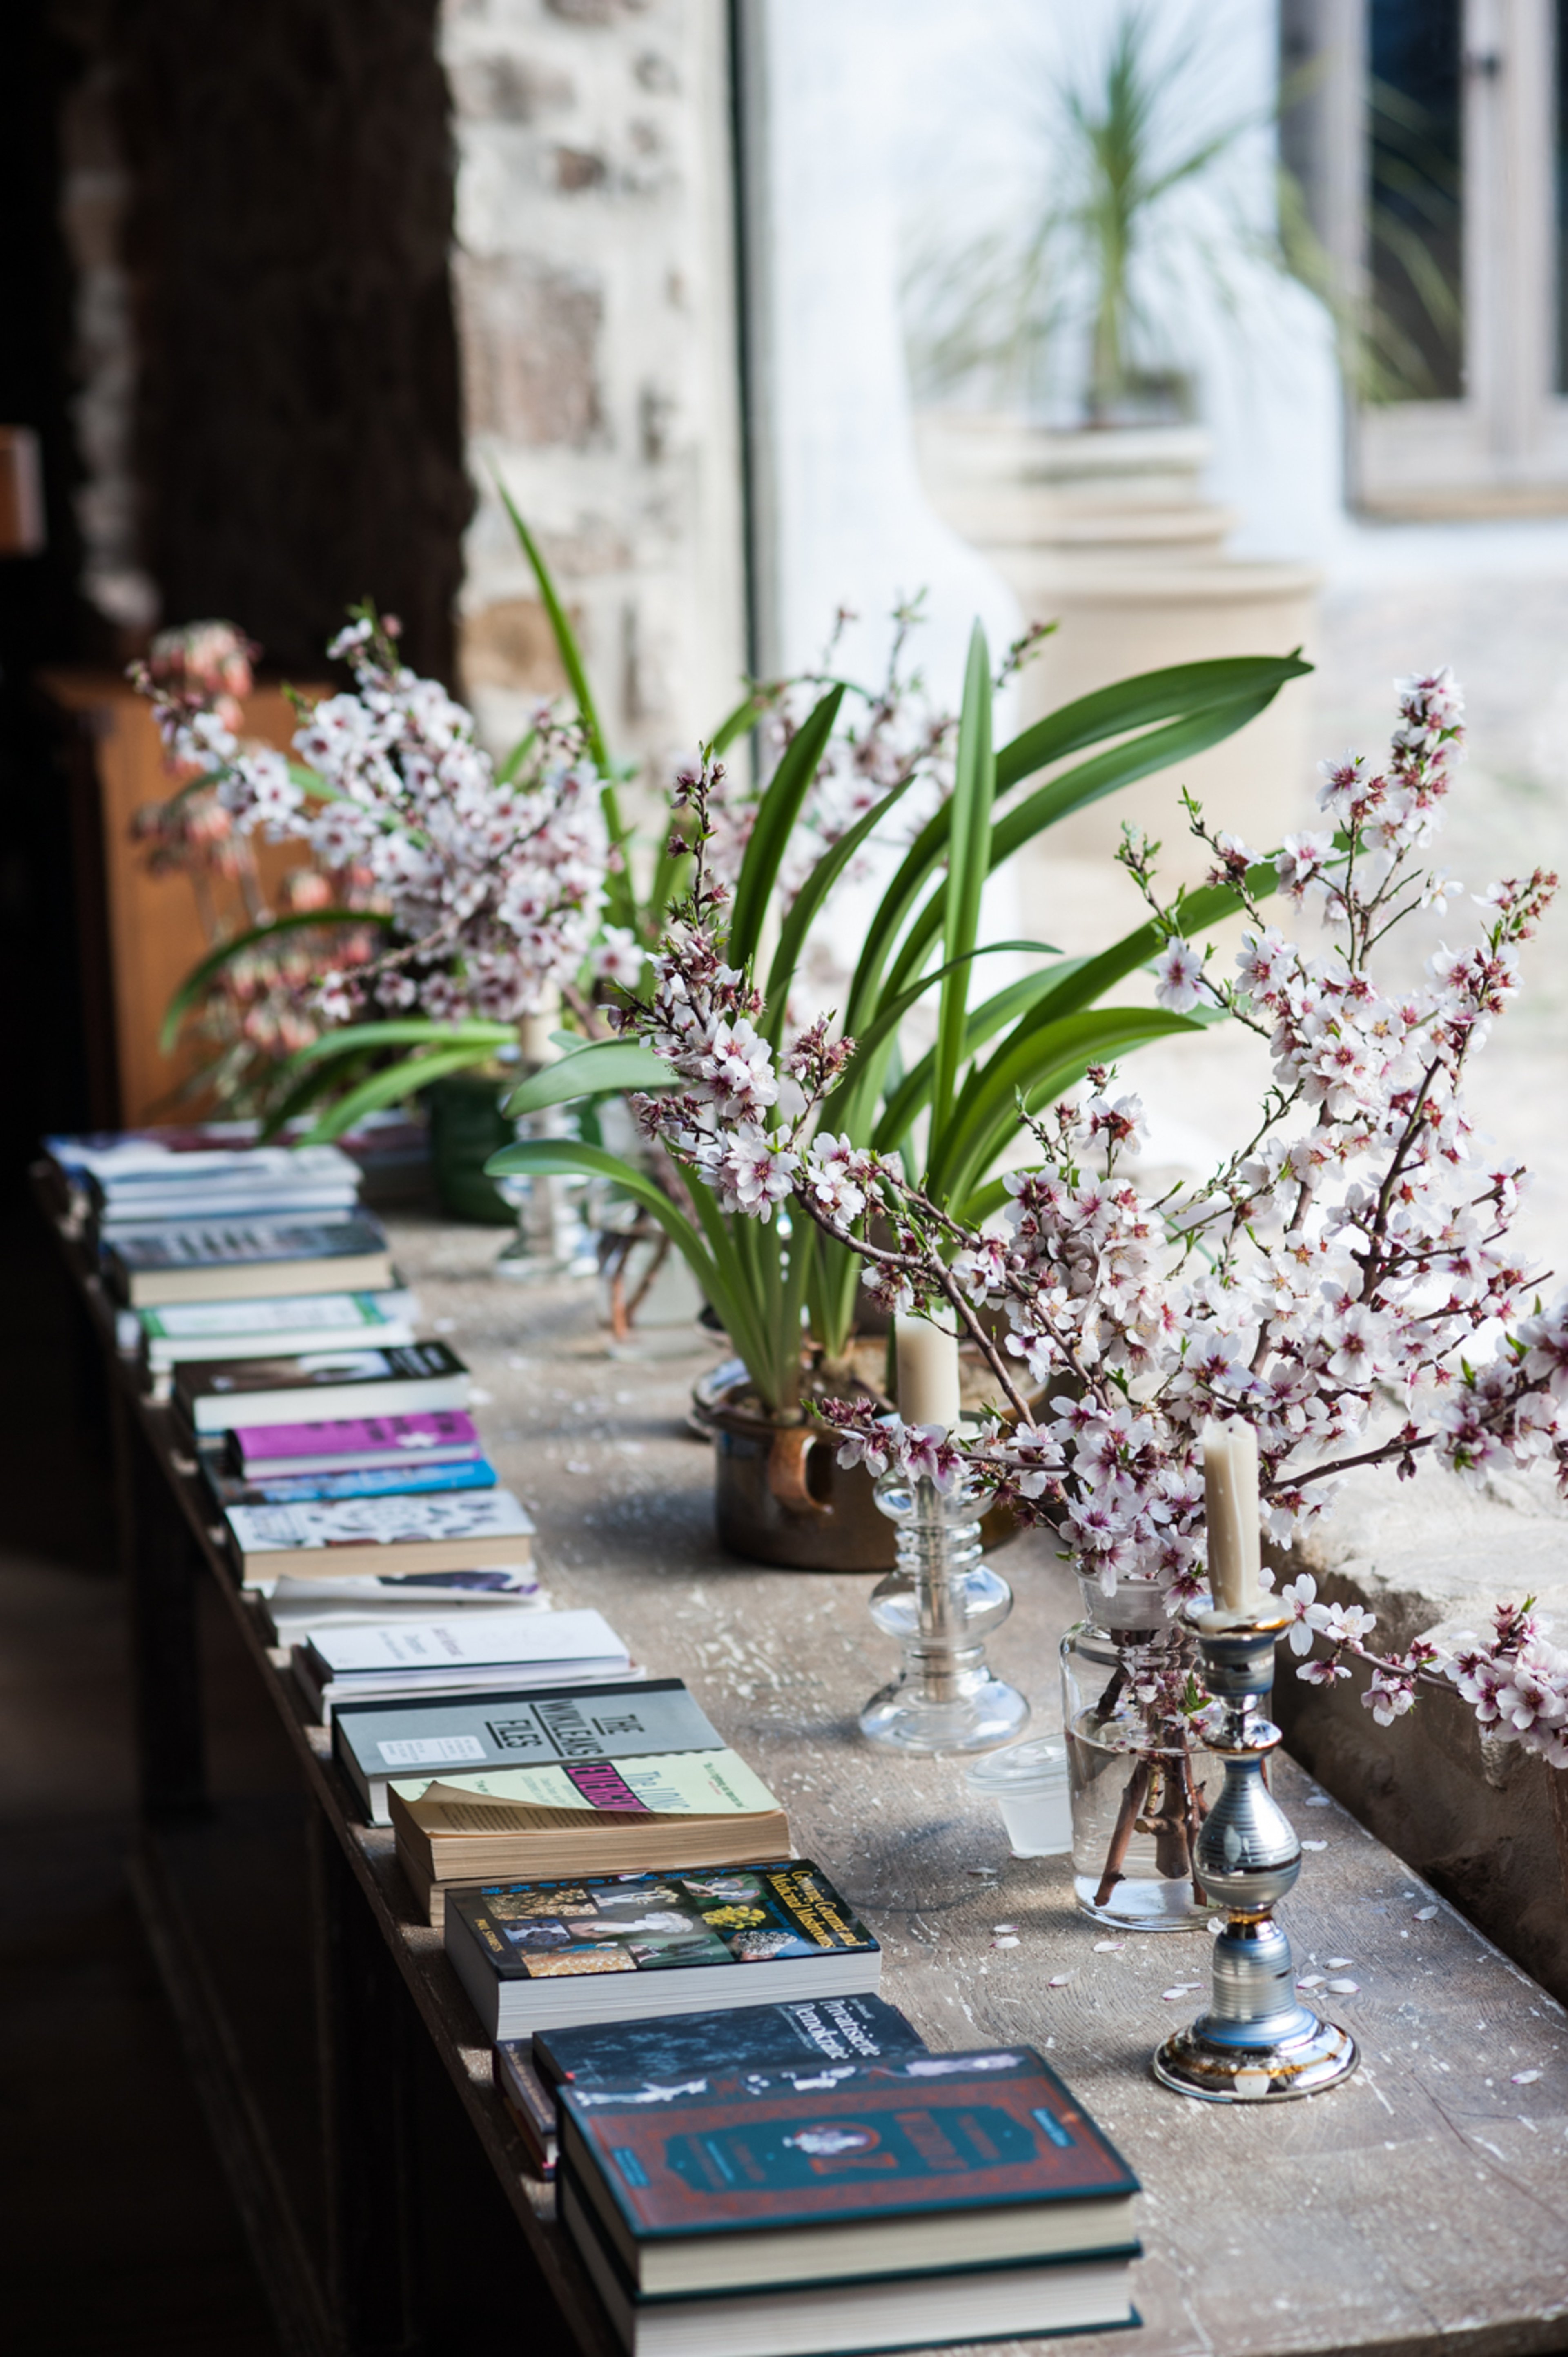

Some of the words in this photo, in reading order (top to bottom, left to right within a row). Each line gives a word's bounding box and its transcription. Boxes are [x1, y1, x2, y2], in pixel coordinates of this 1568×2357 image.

[493, 1719, 543, 1748] FILES
[538, 1700, 604, 1756] WIKILEAKS
[600, 1714, 644, 1734] THE
[623, 1770, 662, 1787] The
[635, 1787, 691, 1809] LONG
[766, 1873, 811, 1908] Medicinal
[792, 1907, 837, 1949] Mushrooms
[791, 1871, 825, 1903] Growing
[815, 1901, 850, 1932] Gourmet
[838, 1932, 868, 1947] and
[788, 2003, 853, 2061] Demokratie
[819, 1999, 880, 2056] Privatisierte
